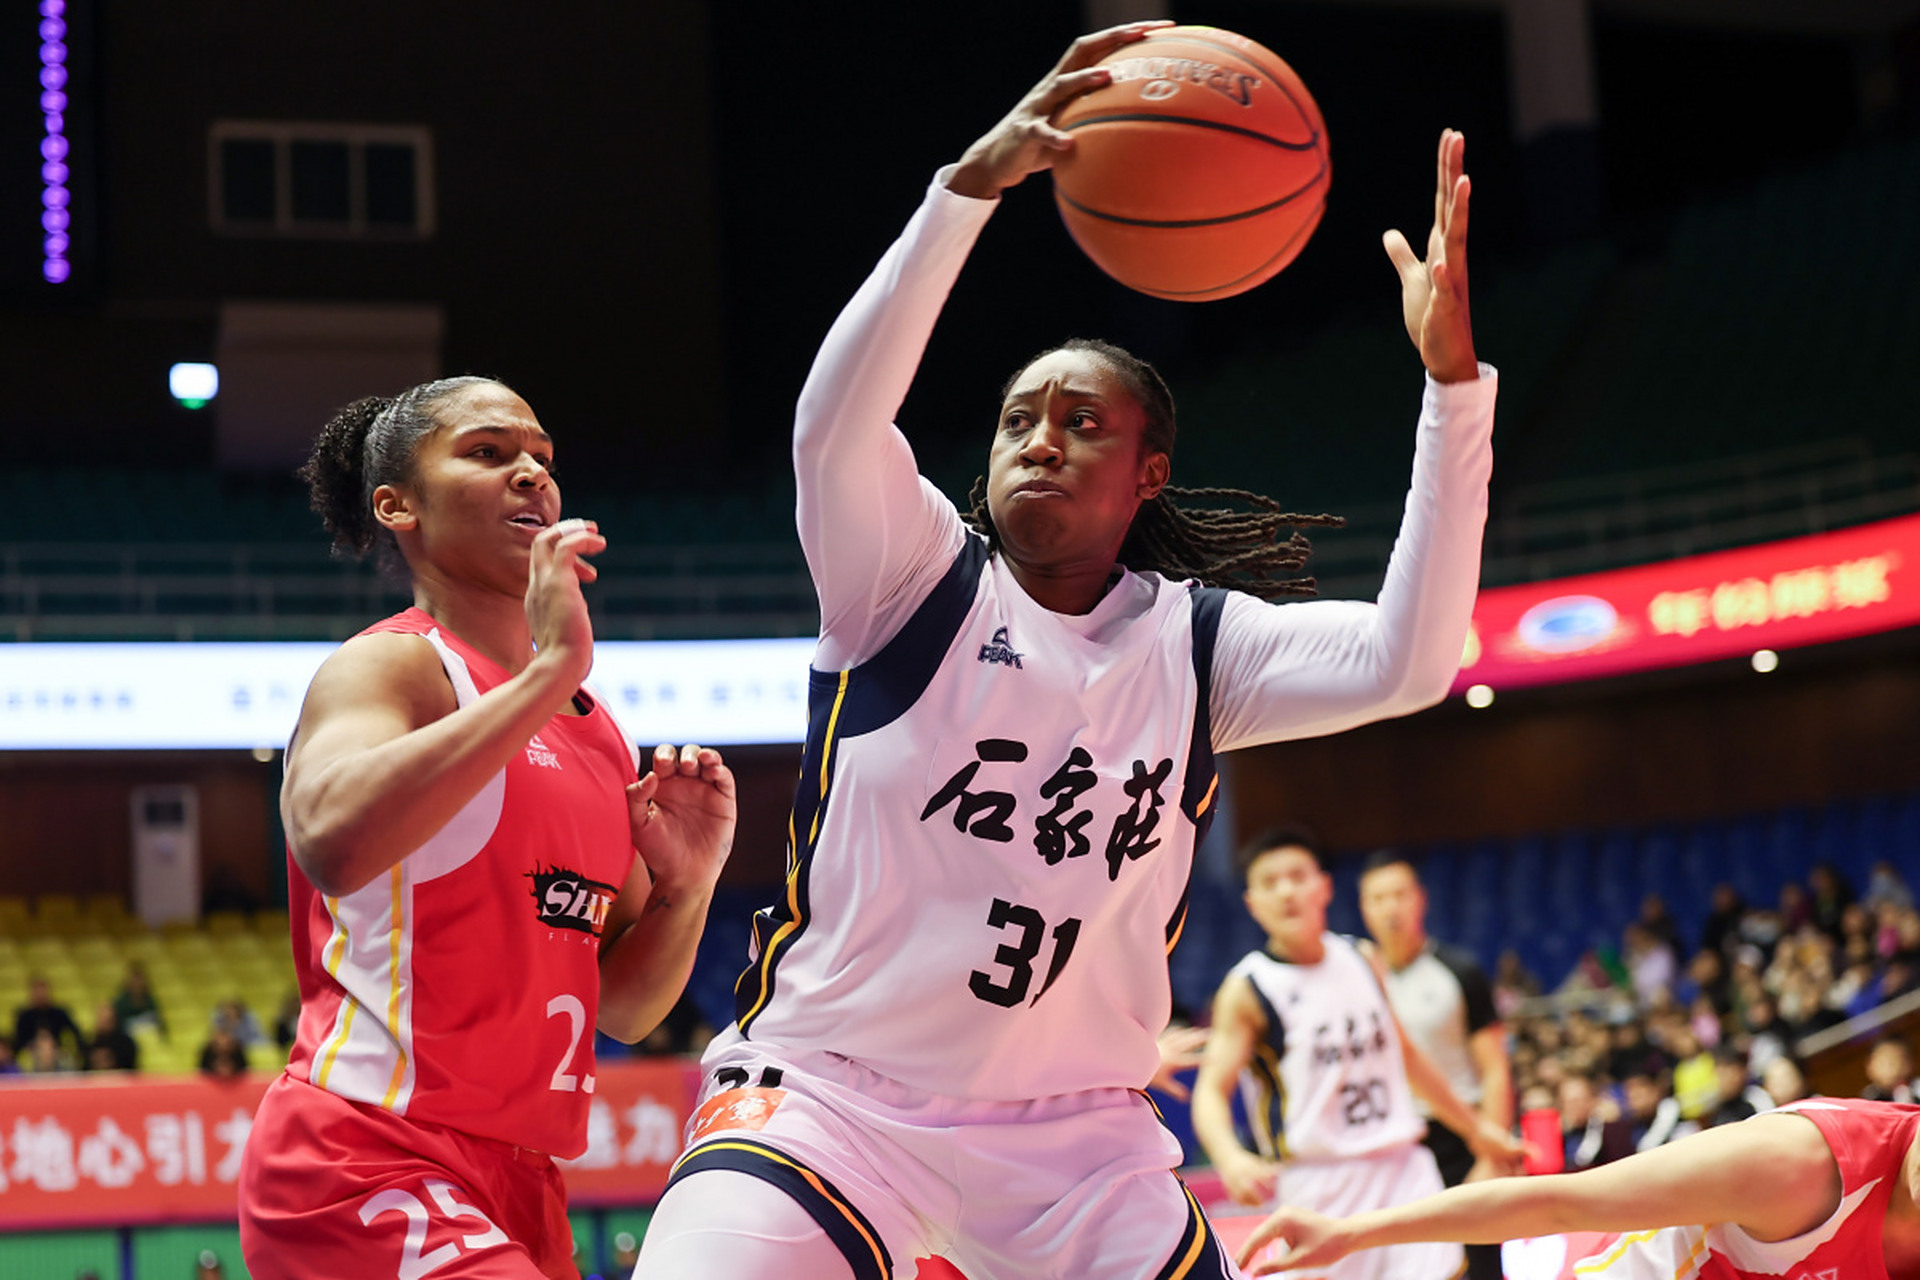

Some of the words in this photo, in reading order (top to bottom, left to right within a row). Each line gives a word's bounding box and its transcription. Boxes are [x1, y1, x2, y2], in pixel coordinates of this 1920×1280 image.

[967, 897, 1083, 1009] 31
[546, 993, 596, 1094] 2
[1341, 1078, 1388, 1126] 20
[357, 1178, 510, 1280] 25
